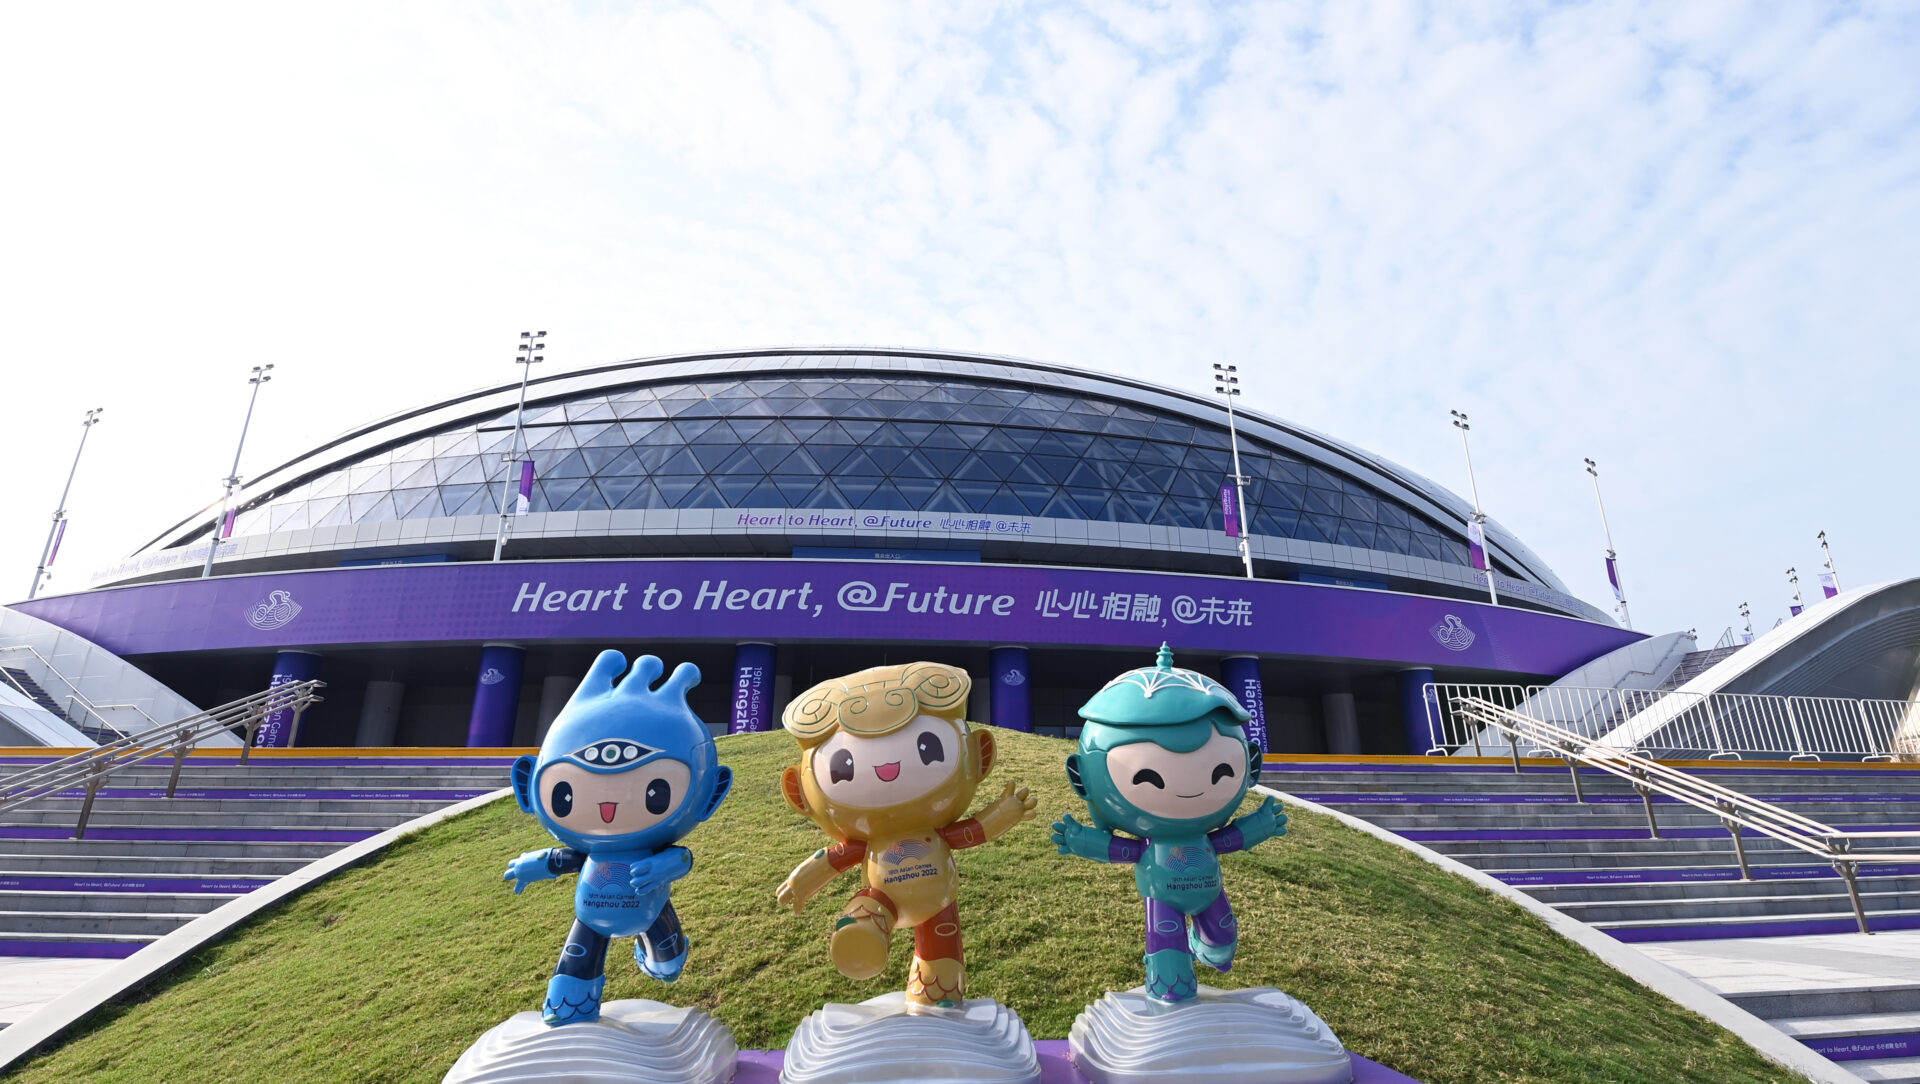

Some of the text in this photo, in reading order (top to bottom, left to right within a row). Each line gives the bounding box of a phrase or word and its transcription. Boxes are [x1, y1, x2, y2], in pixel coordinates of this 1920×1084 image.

[737, 514, 782, 525] Heart
[788, 515, 804, 526] to
[809, 515, 858, 529] Heart,
[863, 515, 932, 529] @Future
[511, 582, 628, 612] Heart
[642, 582, 683, 611] to
[693, 580, 823, 618] Heart,
[837, 581, 1015, 616] @Future
[753, 667, 762, 687] 19th
[751, 689, 761, 716] Asian
[884, 868, 938, 884] Hangzhou 2022
[1167, 882, 1203, 891] Hangzhou
[583, 899, 619, 909] Hangzhou
